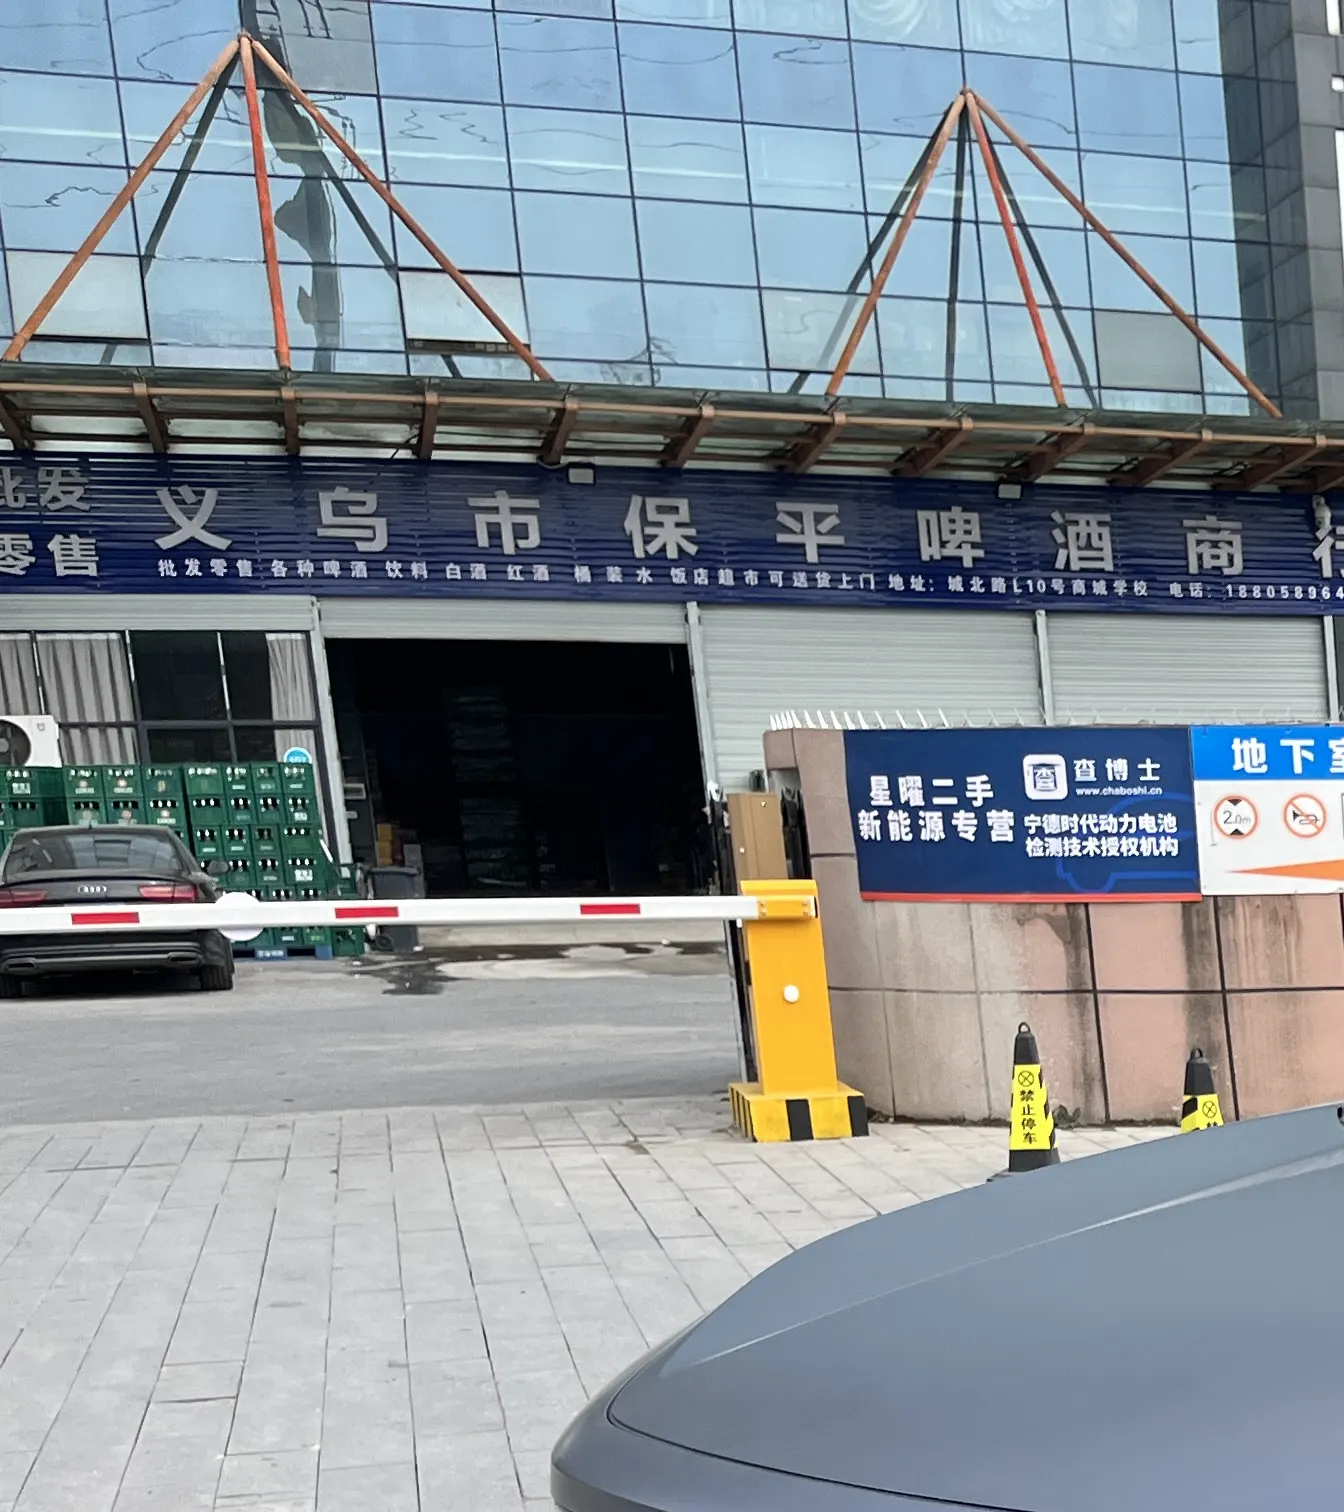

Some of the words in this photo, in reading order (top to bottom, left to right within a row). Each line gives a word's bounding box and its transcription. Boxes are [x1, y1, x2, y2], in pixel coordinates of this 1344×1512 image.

[0, 533, 99, 577] 零售
[1072, 758, 1161, 782] 查博士
[869, 774, 994, 808] 星曜二手
[1075, 785, 1163, 797] www.chaboshi.cn
[857, 808, 1016, 843] 新能源专营
[1023, 812, 1178, 835] 宁德时代动力电池
[1222, 809, 1252, 826] 2.0m
[1025, 836, 1179, 858] 检测技术授权机构
[1019, 1090, 1038, 1145] 禁止停车
